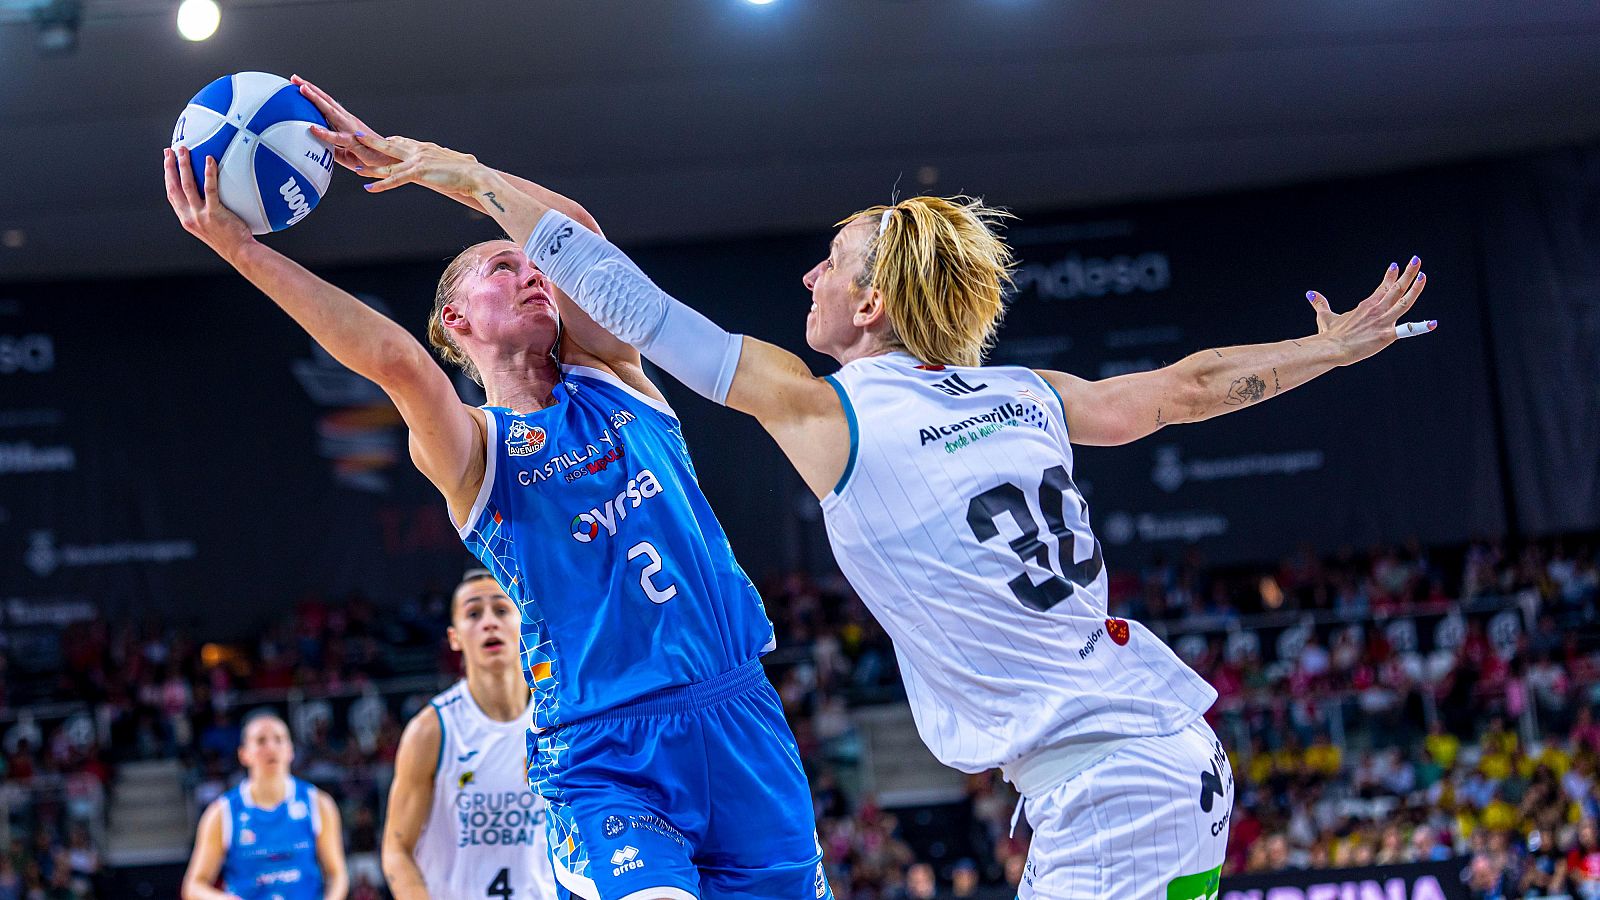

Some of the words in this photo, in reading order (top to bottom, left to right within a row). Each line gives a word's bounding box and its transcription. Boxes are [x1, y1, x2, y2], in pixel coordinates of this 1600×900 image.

[304, 150, 321, 163] NXT
[279, 175, 311, 227] lson
[1012, 250, 1171, 299] ndesa
[599, 429, 615, 447] Y
[919, 402, 1024, 446] Alcantarilla
[565, 467, 589, 484] NOS
[966, 464, 1103, 612] 30
[626, 541, 678, 604] 2
[1078, 627, 1104, 660] Región
[455, 791, 536, 811] GRUPO
[486, 867, 514, 900] 4
[612, 858, 645, 878] errea
